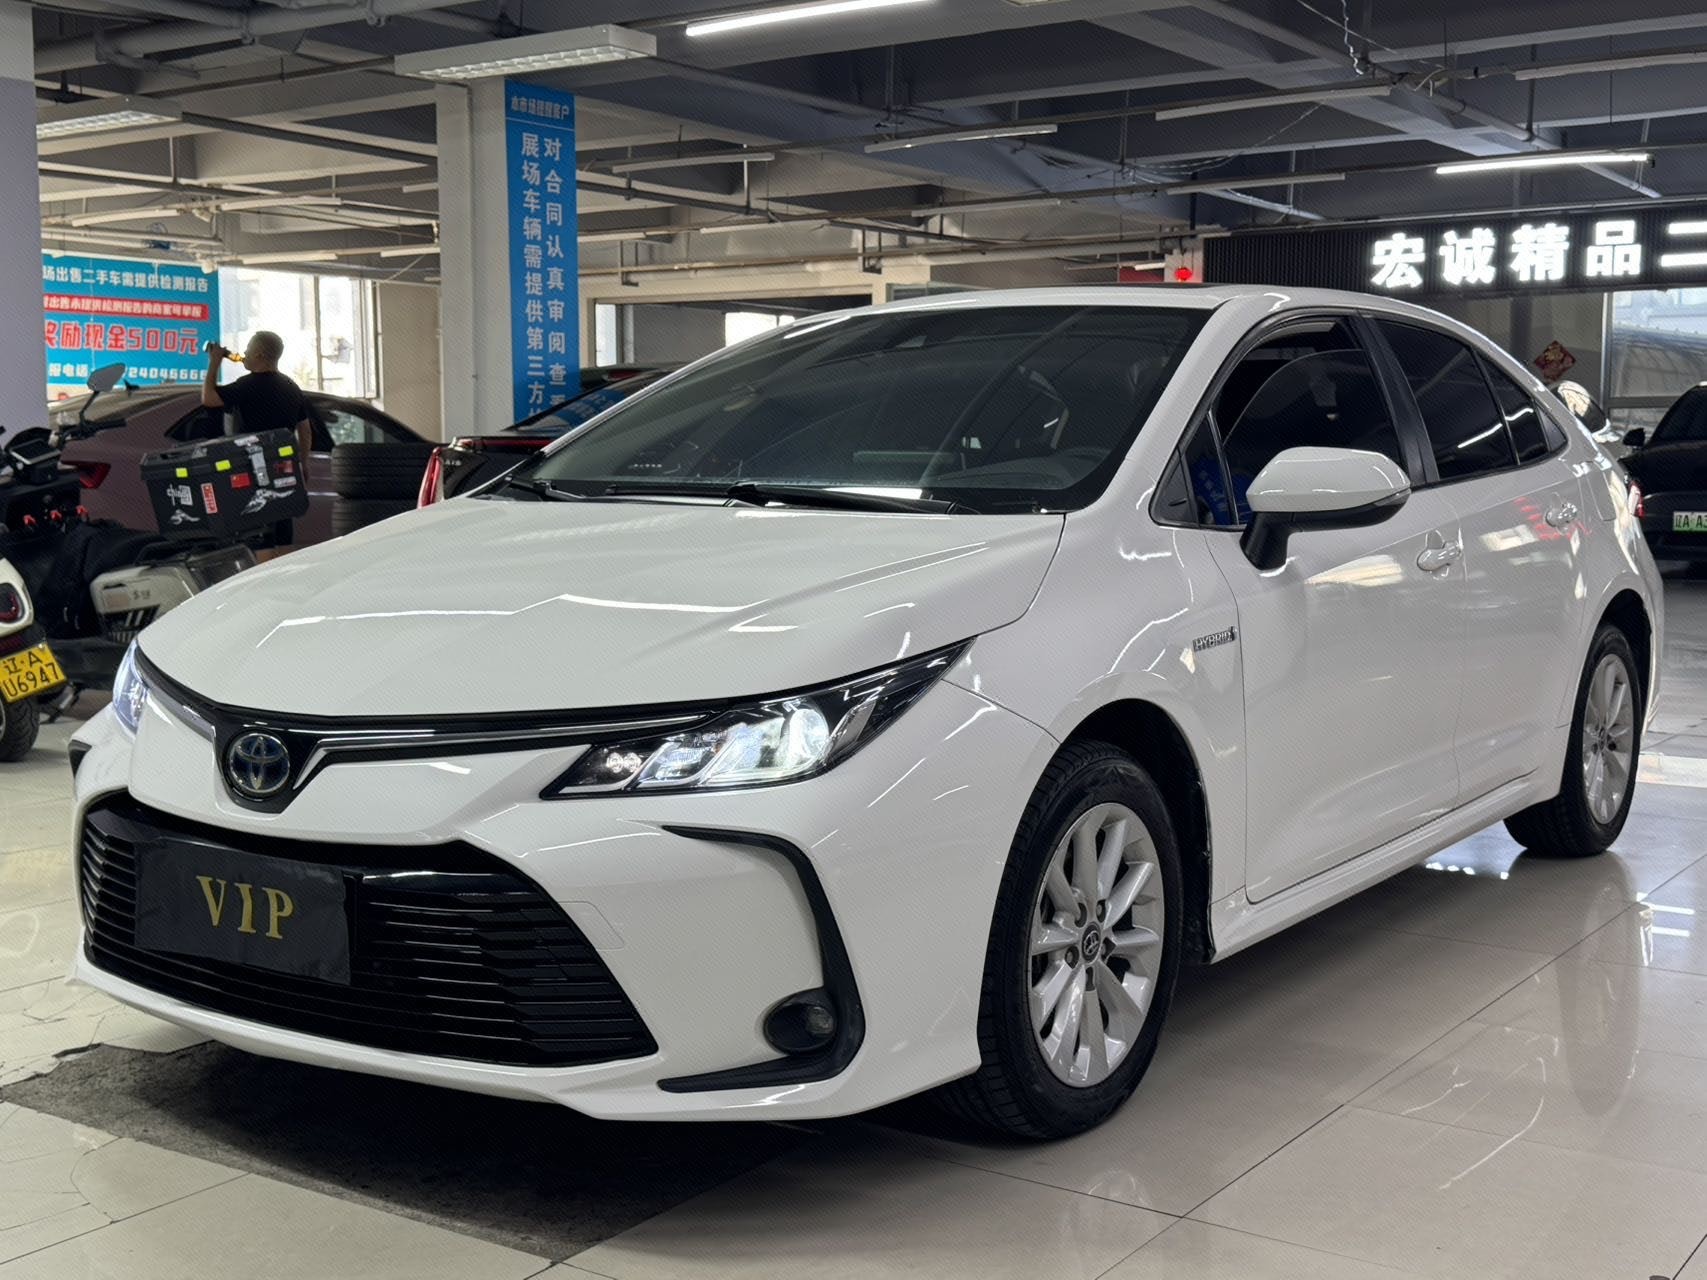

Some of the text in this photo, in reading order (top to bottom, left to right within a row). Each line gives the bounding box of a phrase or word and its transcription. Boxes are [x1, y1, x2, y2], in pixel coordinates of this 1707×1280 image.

[1371, 219, 1707, 288] 宏诚精品二
[45, 319, 199, 355] 奖励现金500元
[1193, 630, 1235, 652] HYBRID
[3, 662, 59, 697] U6947
[195, 875, 294, 939] VIP
